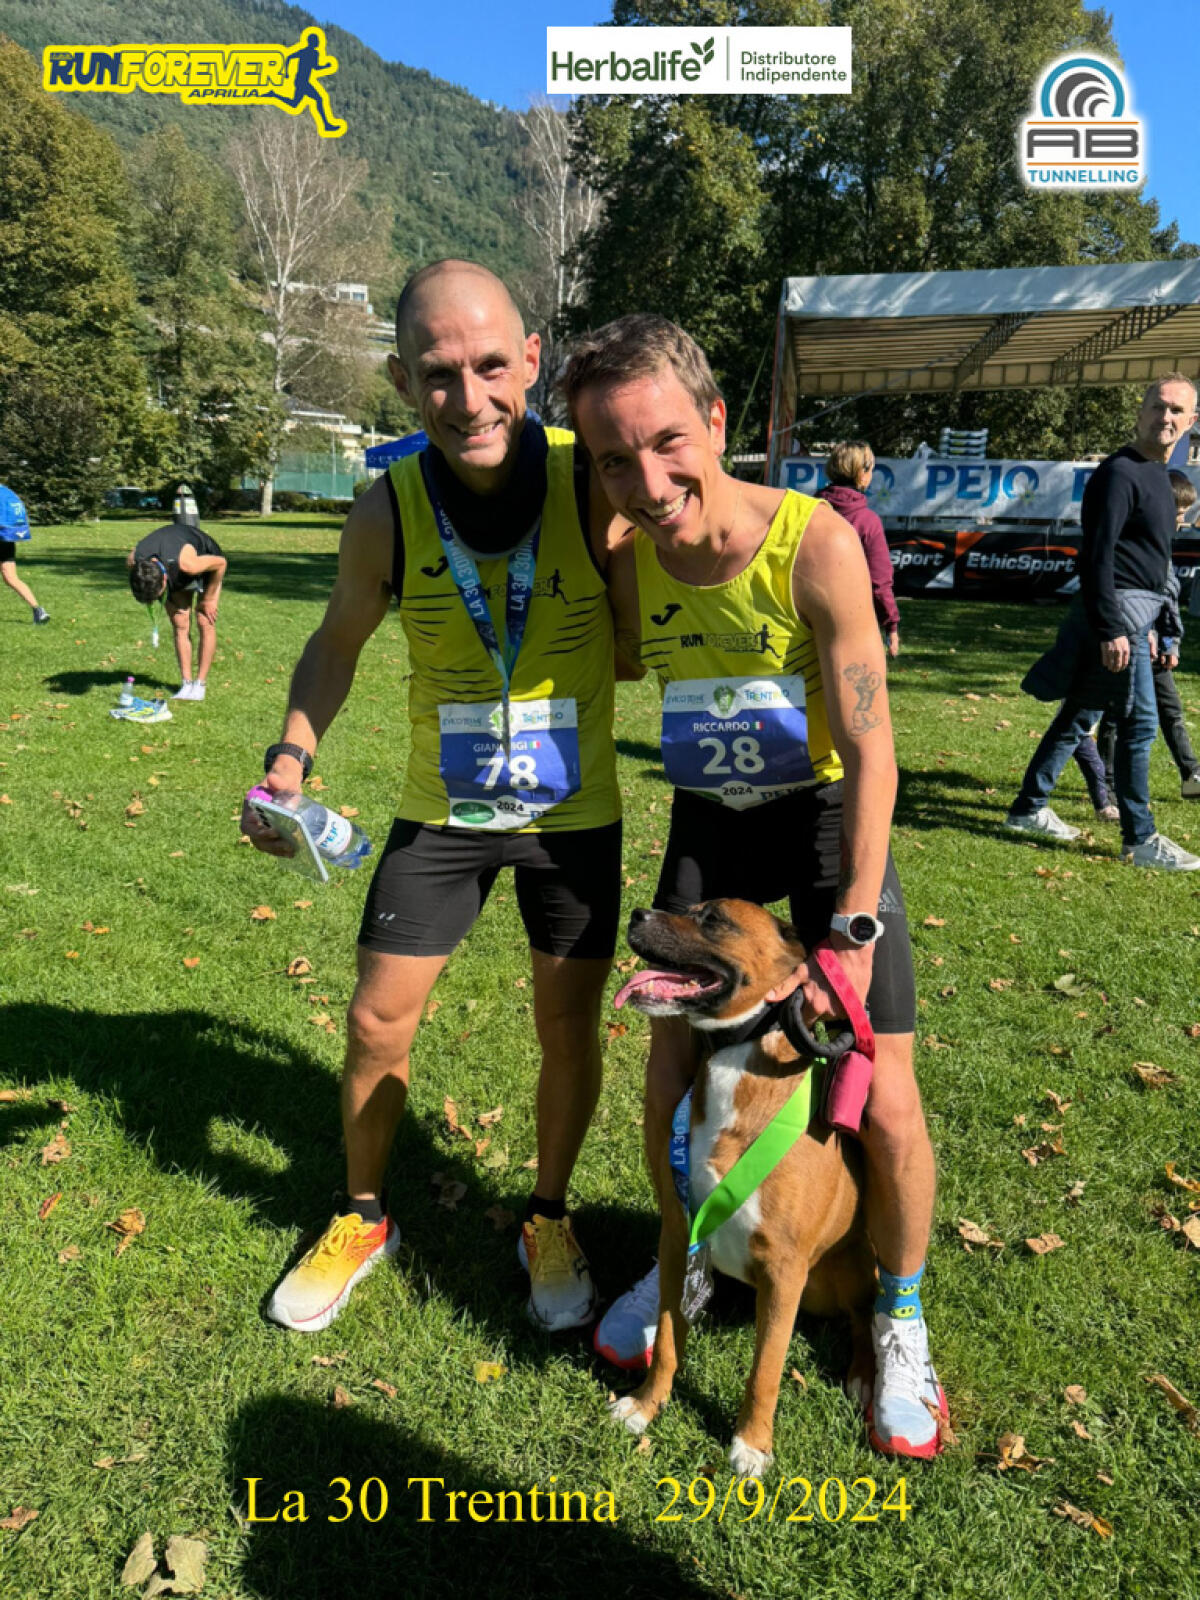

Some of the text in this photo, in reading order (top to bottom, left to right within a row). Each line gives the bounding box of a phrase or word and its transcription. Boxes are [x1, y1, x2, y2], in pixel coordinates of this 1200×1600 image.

[926, 465, 1040, 507] PEJO
[966, 552, 1076, 574] EthicSport
[693, 721, 751, 732] RICCARDO
[698, 736, 765, 775] 28
[476, 755, 540, 790] 78
[722, 786, 754, 796] 2024
[496, 800, 525, 812] 2024
